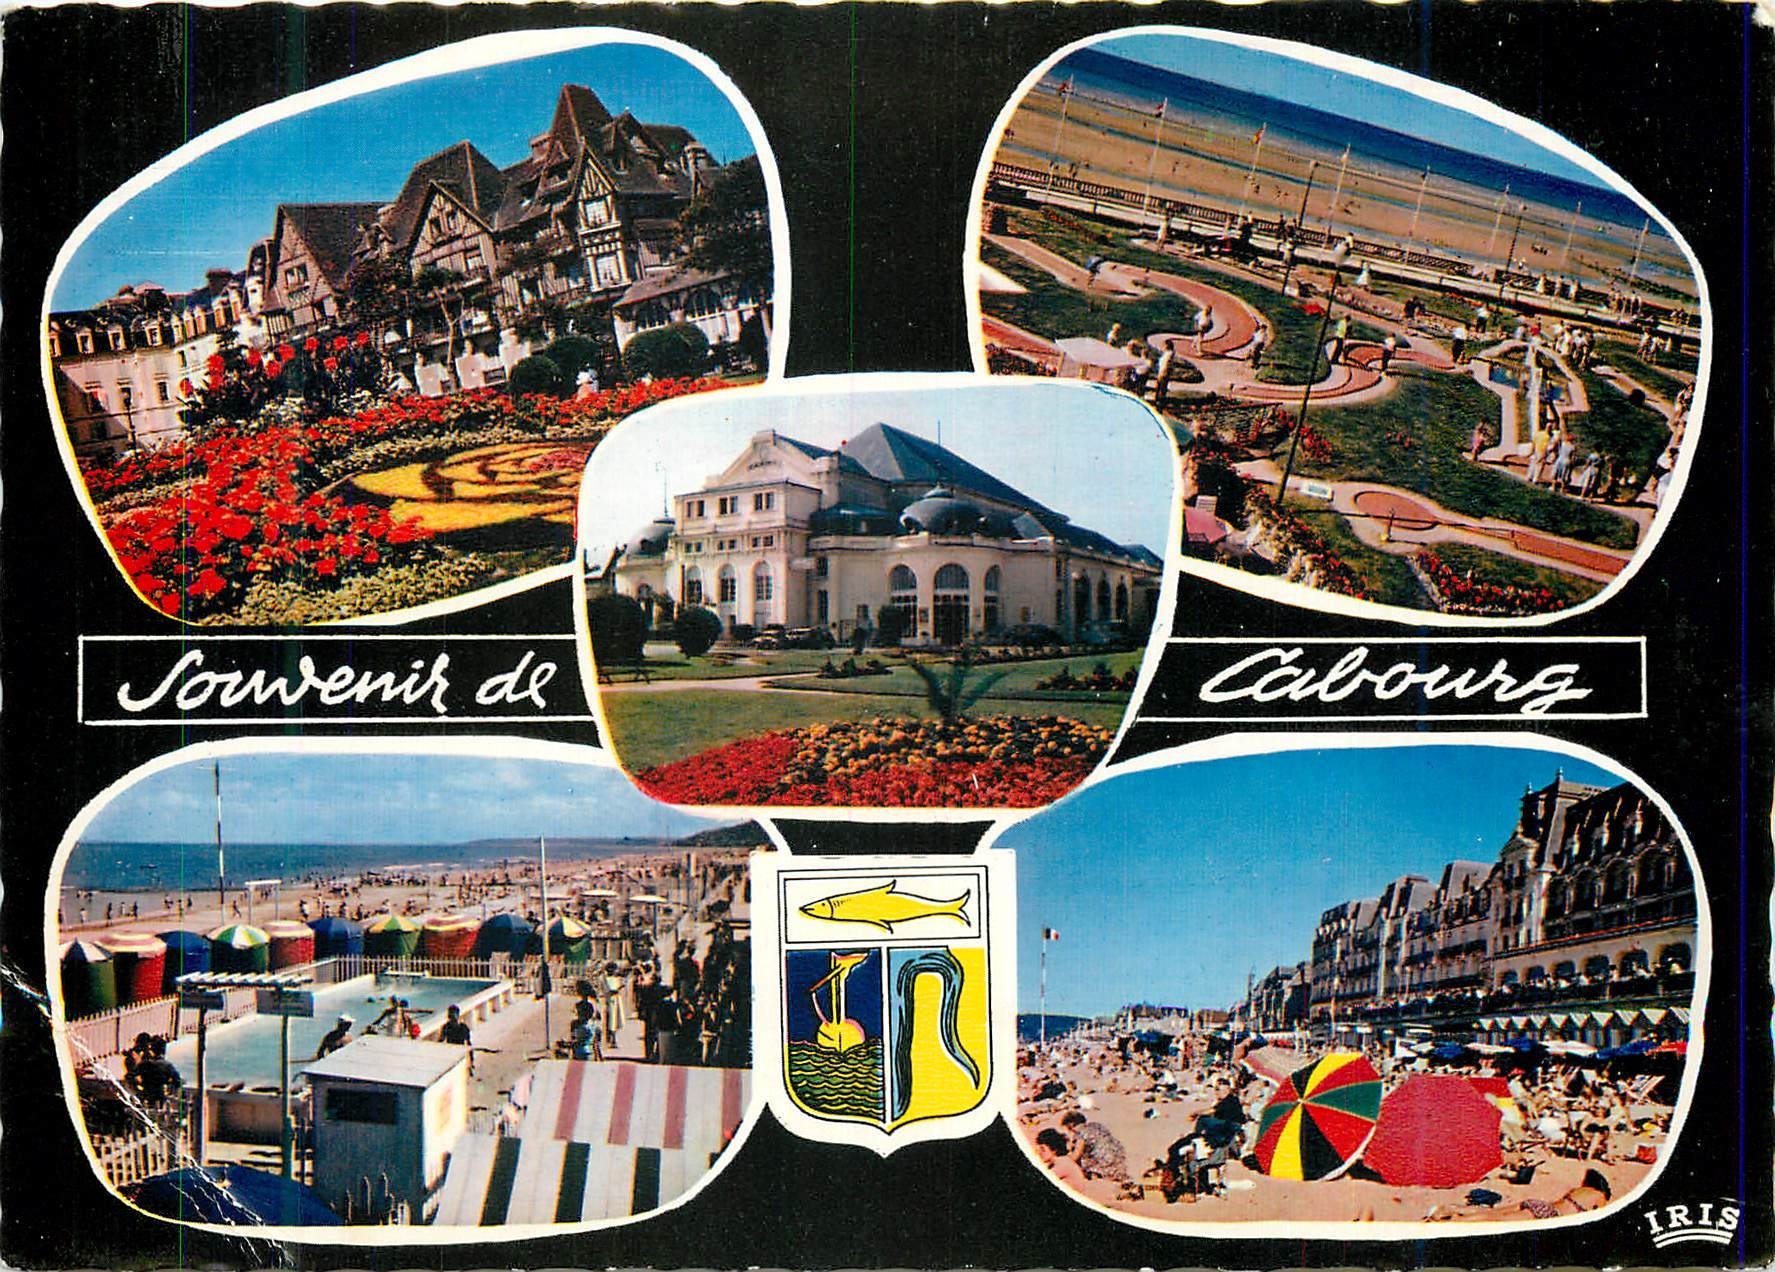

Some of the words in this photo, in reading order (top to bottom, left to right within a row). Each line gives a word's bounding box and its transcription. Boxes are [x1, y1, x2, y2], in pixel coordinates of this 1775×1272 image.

[117, 649, 450, 713] Souvenir
[475, 650, 558, 709] de
[1199, 646, 1593, 715] Cabourg
[1643, 1203, 1740, 1234] IRIS
